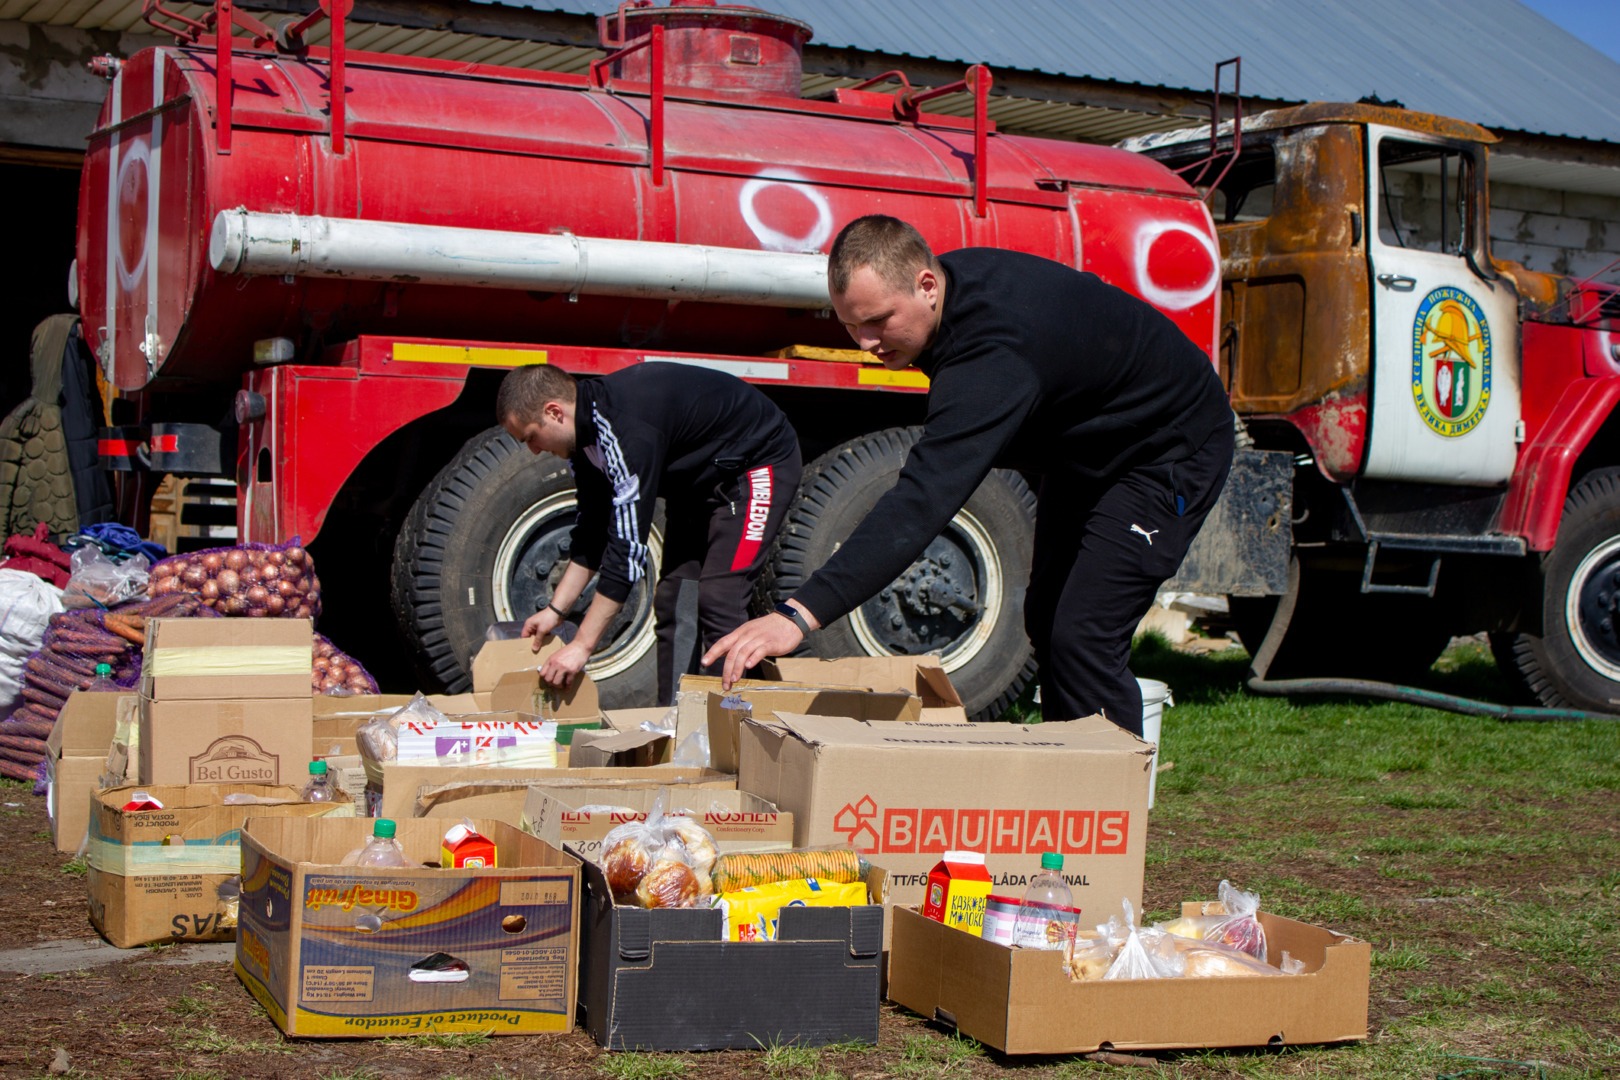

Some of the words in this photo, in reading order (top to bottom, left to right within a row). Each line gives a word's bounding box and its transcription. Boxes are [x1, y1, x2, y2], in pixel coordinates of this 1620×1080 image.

[1427, 289, 1476, 312] ПОЖЕЖНА
[1416, 394, 1446, 432] ВЕЛИКА
[1450, 398, 1488, 434] ДИМЕРКА
[745, 467, 771, 541] WIMBLEDON
[196, 766, 223, 780] Bel
[227, 765, 273, 780] Gusto
[145, 820, 179, 828] PRODUCT
[886, 812, 1126, 850] BAUHAUS
[990, 872, 1027, 886] LÅDA
[305, 884, 418, 913] Ginafruit
[344, 1017, 422, 1030] Ecuador
[426, 1016, 444, 1028] of
[448, 1013, 521, 1025] Product
